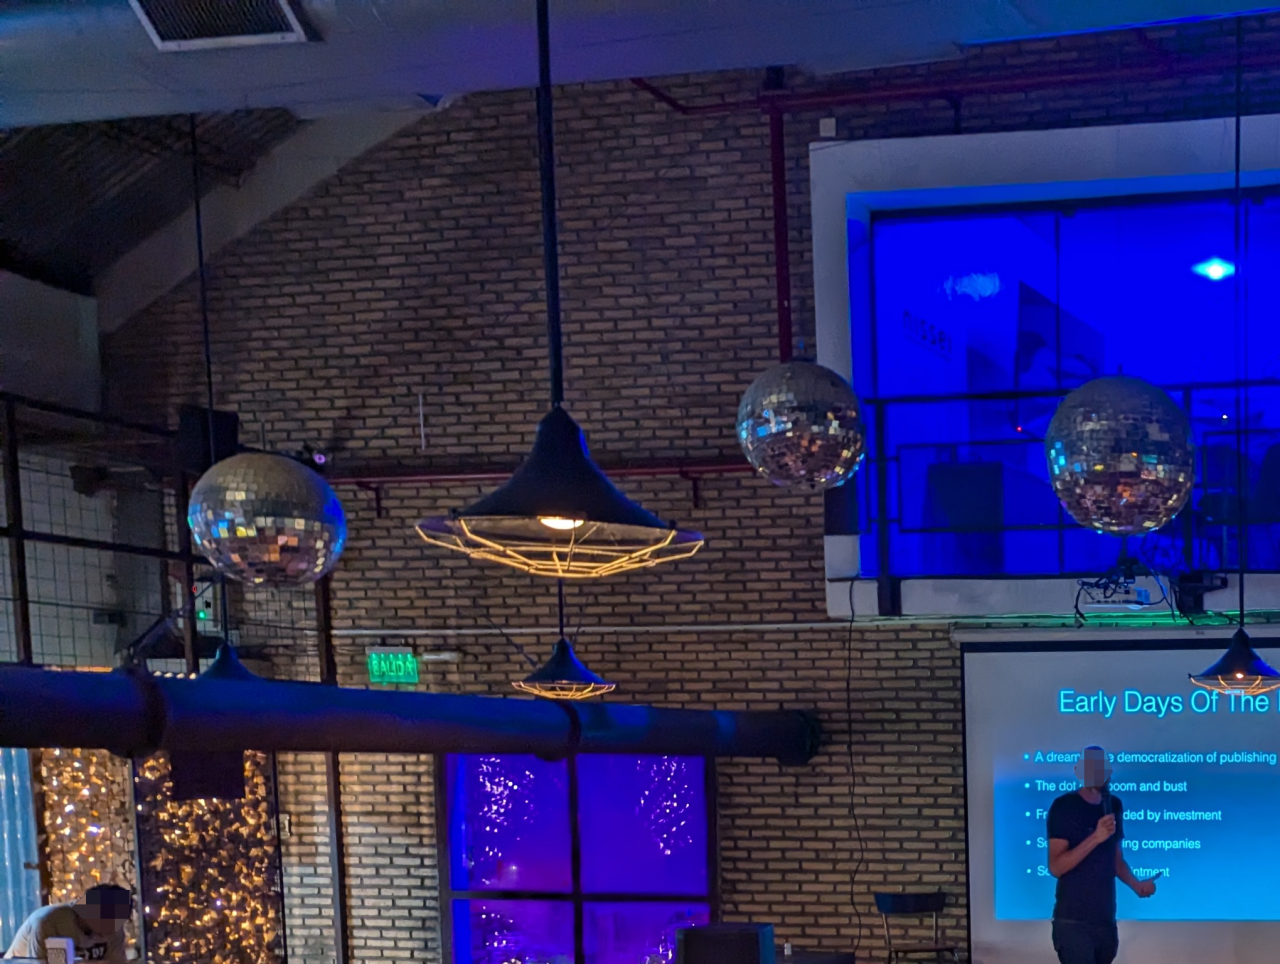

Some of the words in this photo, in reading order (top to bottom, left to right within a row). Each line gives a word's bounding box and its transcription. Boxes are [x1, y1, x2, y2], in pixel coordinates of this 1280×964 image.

[371, 660, 413, 676] SALIDA
[1059, 690, 1117, 718] Early
[1125, 691, 1183, 718] Days
[1190, 690, 1219, 713] Of
[1225, 690, 1269, 713] The
[1034, 751, 1044, 763] A
[1117, 751, 1204, 763] democratization
[1206, 751, 1218, 763] of
[1219, 751, 1278, 766] publishing
[1035, 780, 1057, 792] The
[1058, 780, 1077, 792] dot
[1139, 780, 1161, 792] and
[1163, 780, 1188, 792] bust
[1146, 809, 1162, 823] by
[1163, 809, 1222, 821] investment
[1141, 838, 1201, 851] companies
